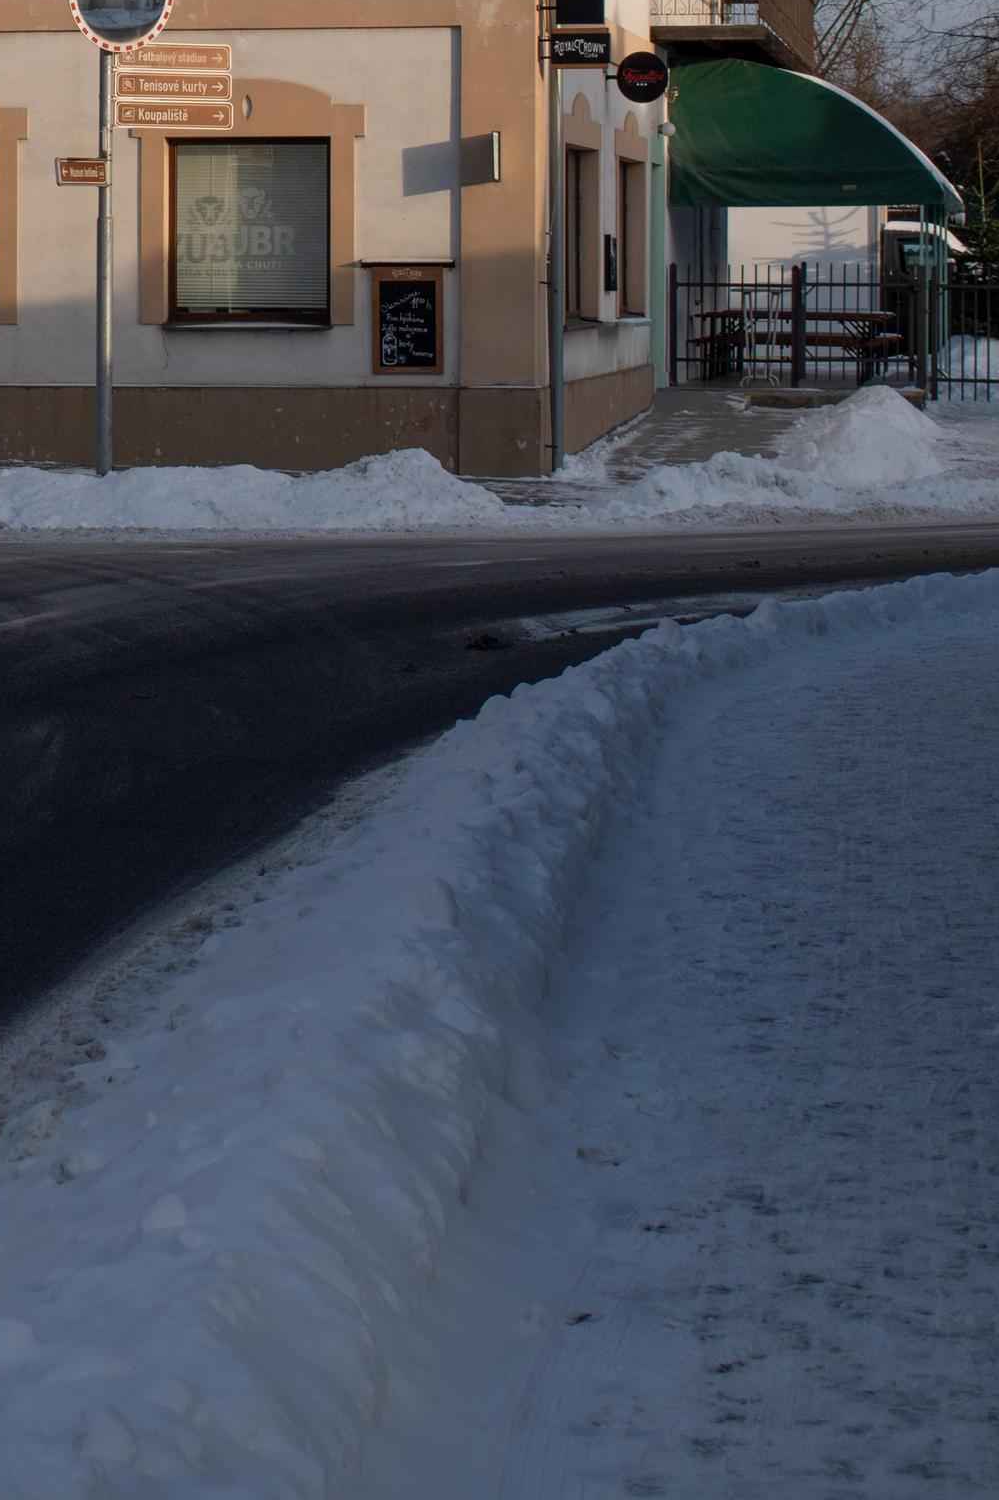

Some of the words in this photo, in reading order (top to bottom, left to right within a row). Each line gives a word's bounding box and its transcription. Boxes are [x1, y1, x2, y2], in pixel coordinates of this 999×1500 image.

[554, 40, 576, 56] ROYAL
[574, 39, 605, 55] CROWN
[138, 50, 177, 65] Fotbalový
[178, 52, 207, 64] stadion
[139, 79, 180, 92] Tenisové
[182, 80, 207, 96] kurty
[138, 107, 188, 124] Koupaliště
